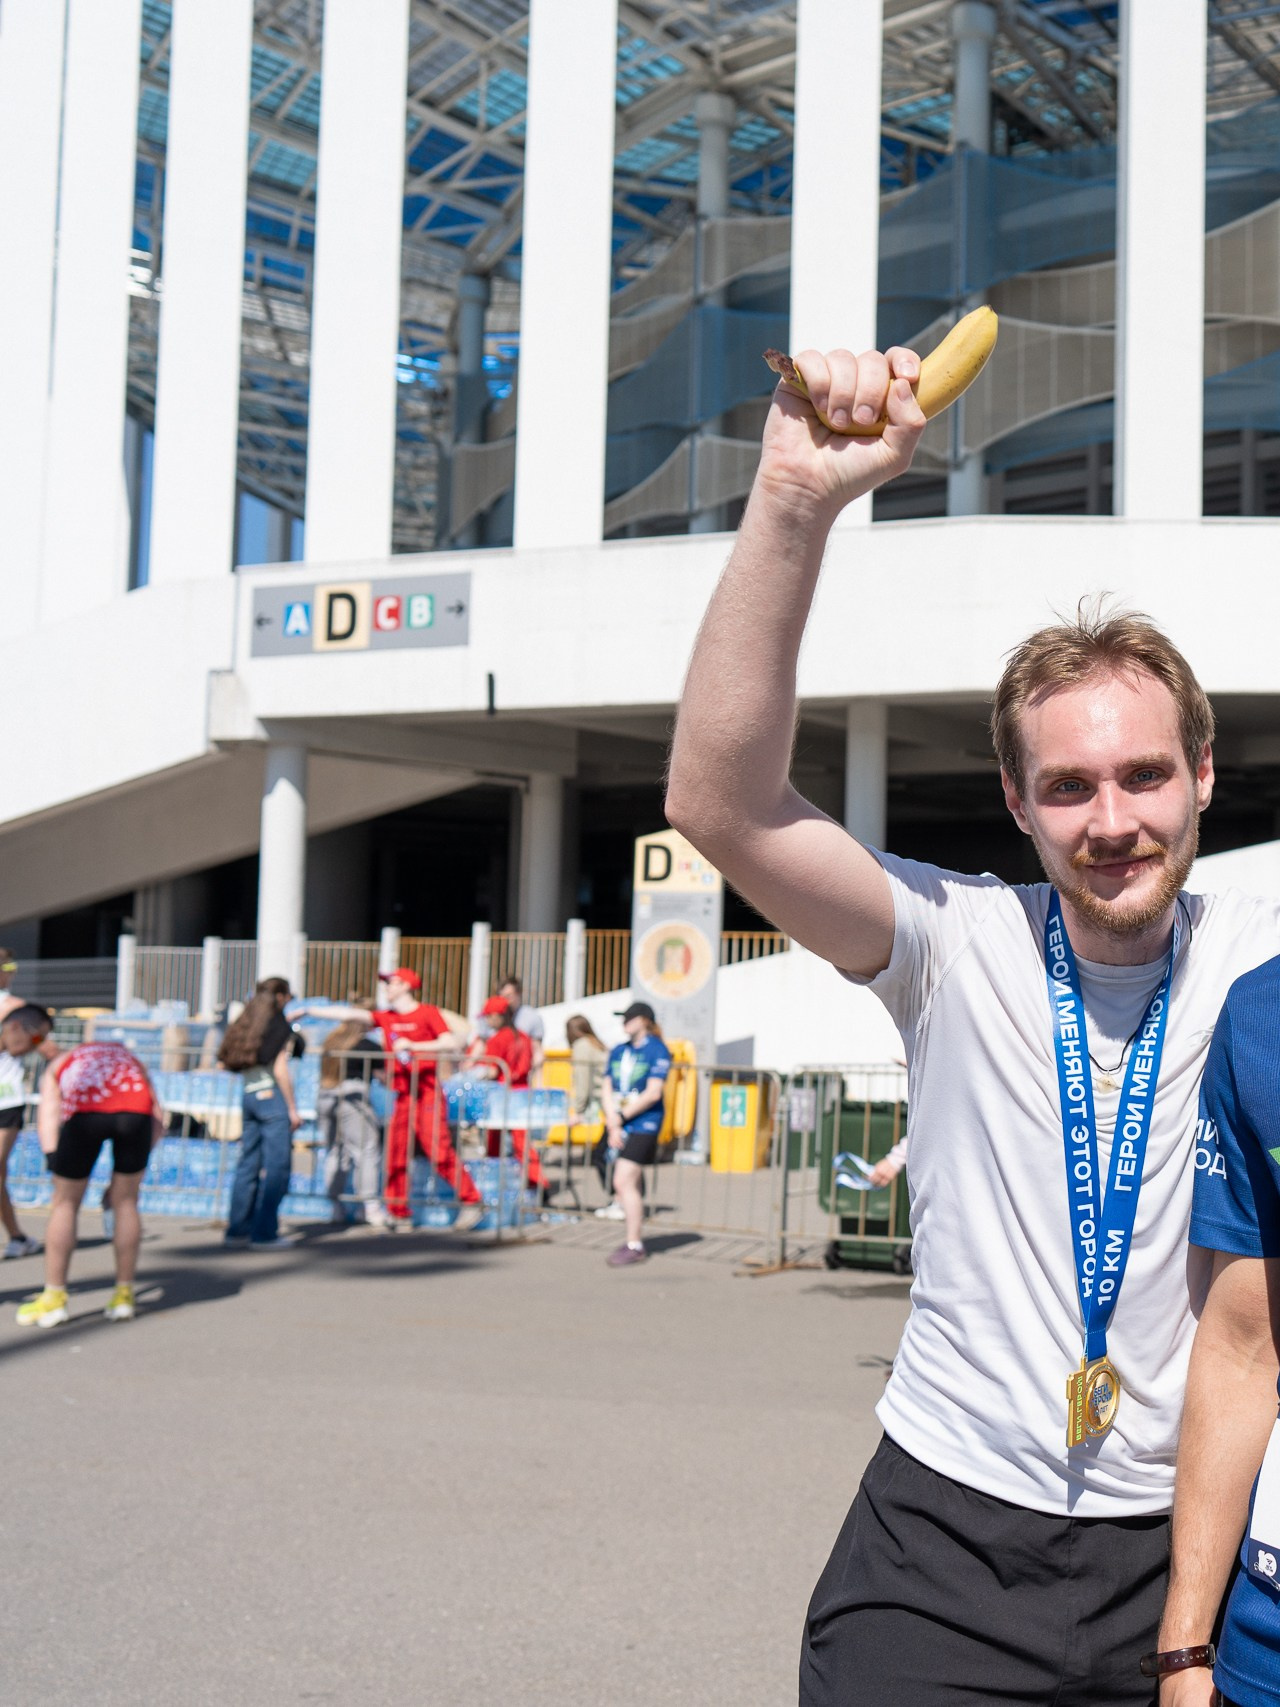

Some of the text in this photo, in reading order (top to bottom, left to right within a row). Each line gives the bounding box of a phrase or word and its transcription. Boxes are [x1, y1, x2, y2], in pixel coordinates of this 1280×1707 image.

[285, 592, 432, 641] A D C B
[643, 844, 672, 882] D
[1048, 914, 1073, 996] ГЕРОИ
[1057, 1000, 1088, 1119] МЕНЯЮТ
[1071, 1124, 1093, 1198] ЭТОТ
[1114, 1103, 1146, 1192] ГЕРОИ
[1098, 1229, 1125, 1306] 10 КМ
